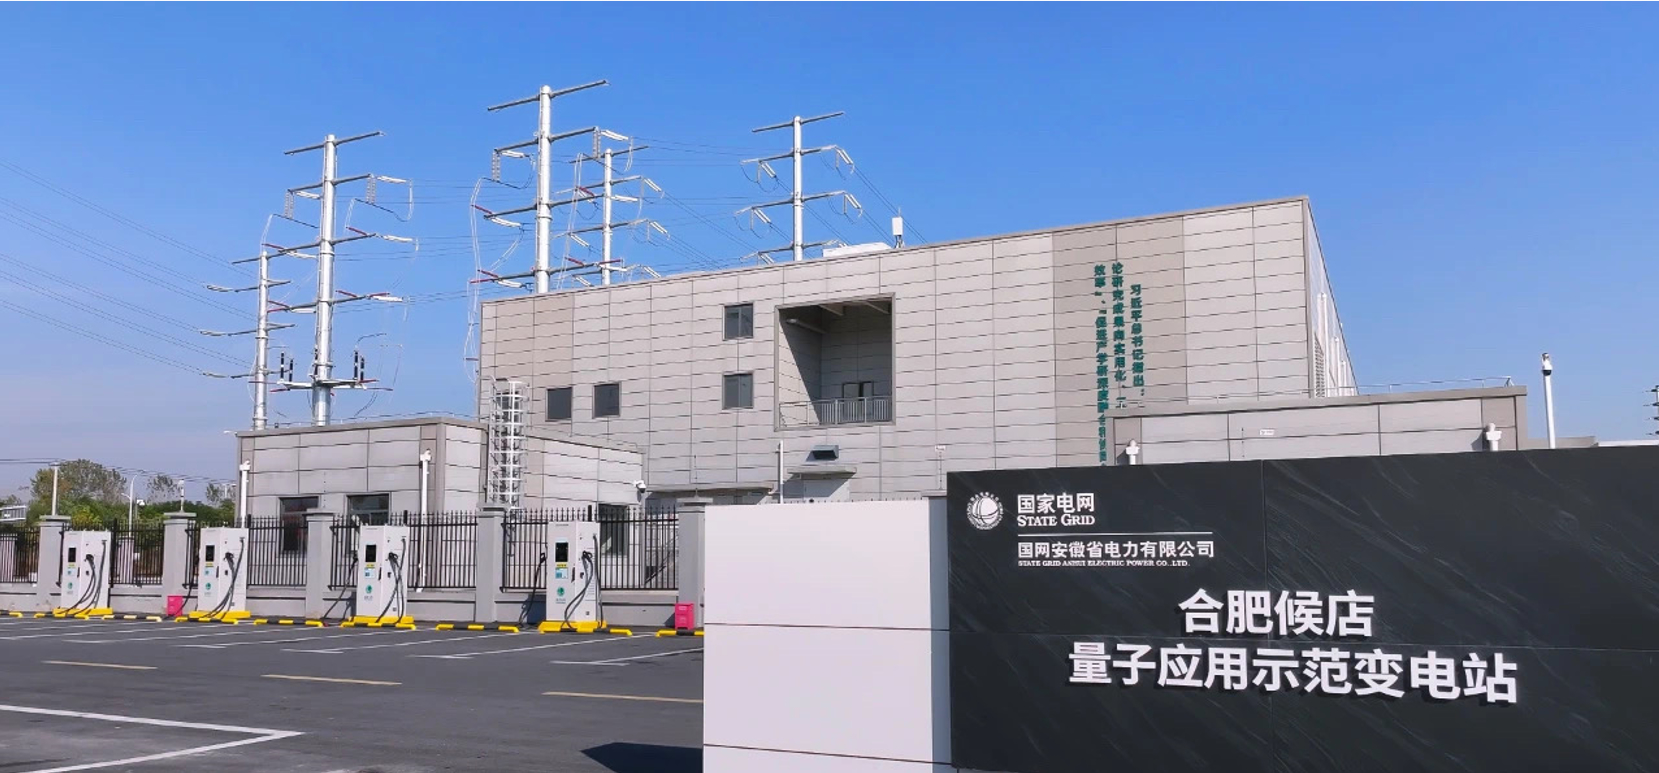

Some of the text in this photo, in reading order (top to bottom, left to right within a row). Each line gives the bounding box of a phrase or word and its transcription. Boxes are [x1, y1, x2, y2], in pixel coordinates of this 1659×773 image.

[1017, 492, 1095, 514] 国家电网
[1017, 513, 1096, 527] STATE GRID
[1017, 540, 1215, 559] 国网安徽省电力有限公司
[1178, 587, 1375, 638] 合肥候店
[1068, 641, 1518, 704] 量子应用示范变电站
